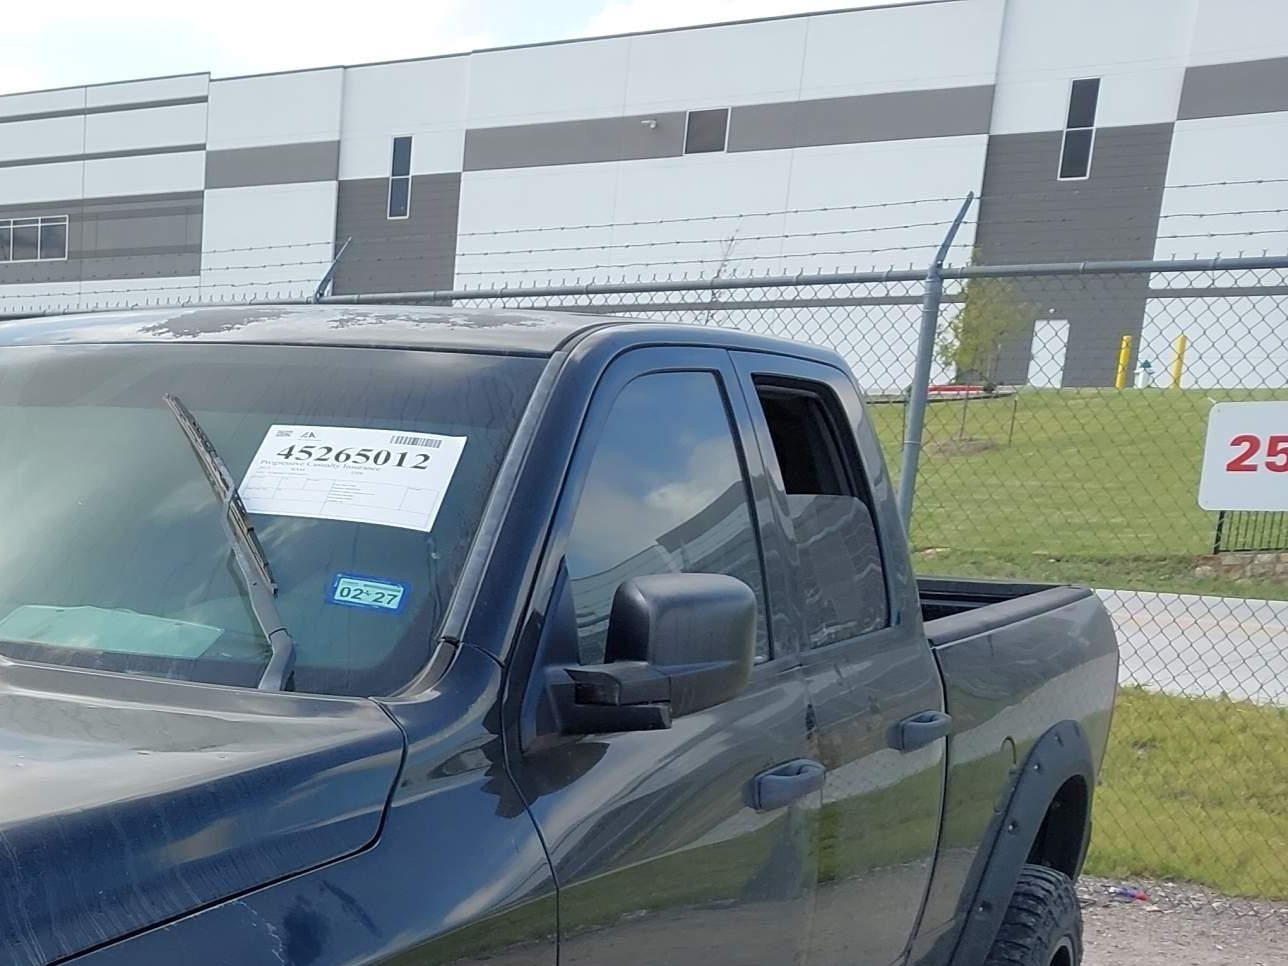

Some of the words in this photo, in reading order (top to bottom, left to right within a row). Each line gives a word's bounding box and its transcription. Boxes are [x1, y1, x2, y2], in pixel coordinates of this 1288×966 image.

[277, 444, 431, 470] 45265012
[1225, 434, 1288, 472] 25
[340, 586, 364, 600] 02
[372, 591, 399, 605] 27
